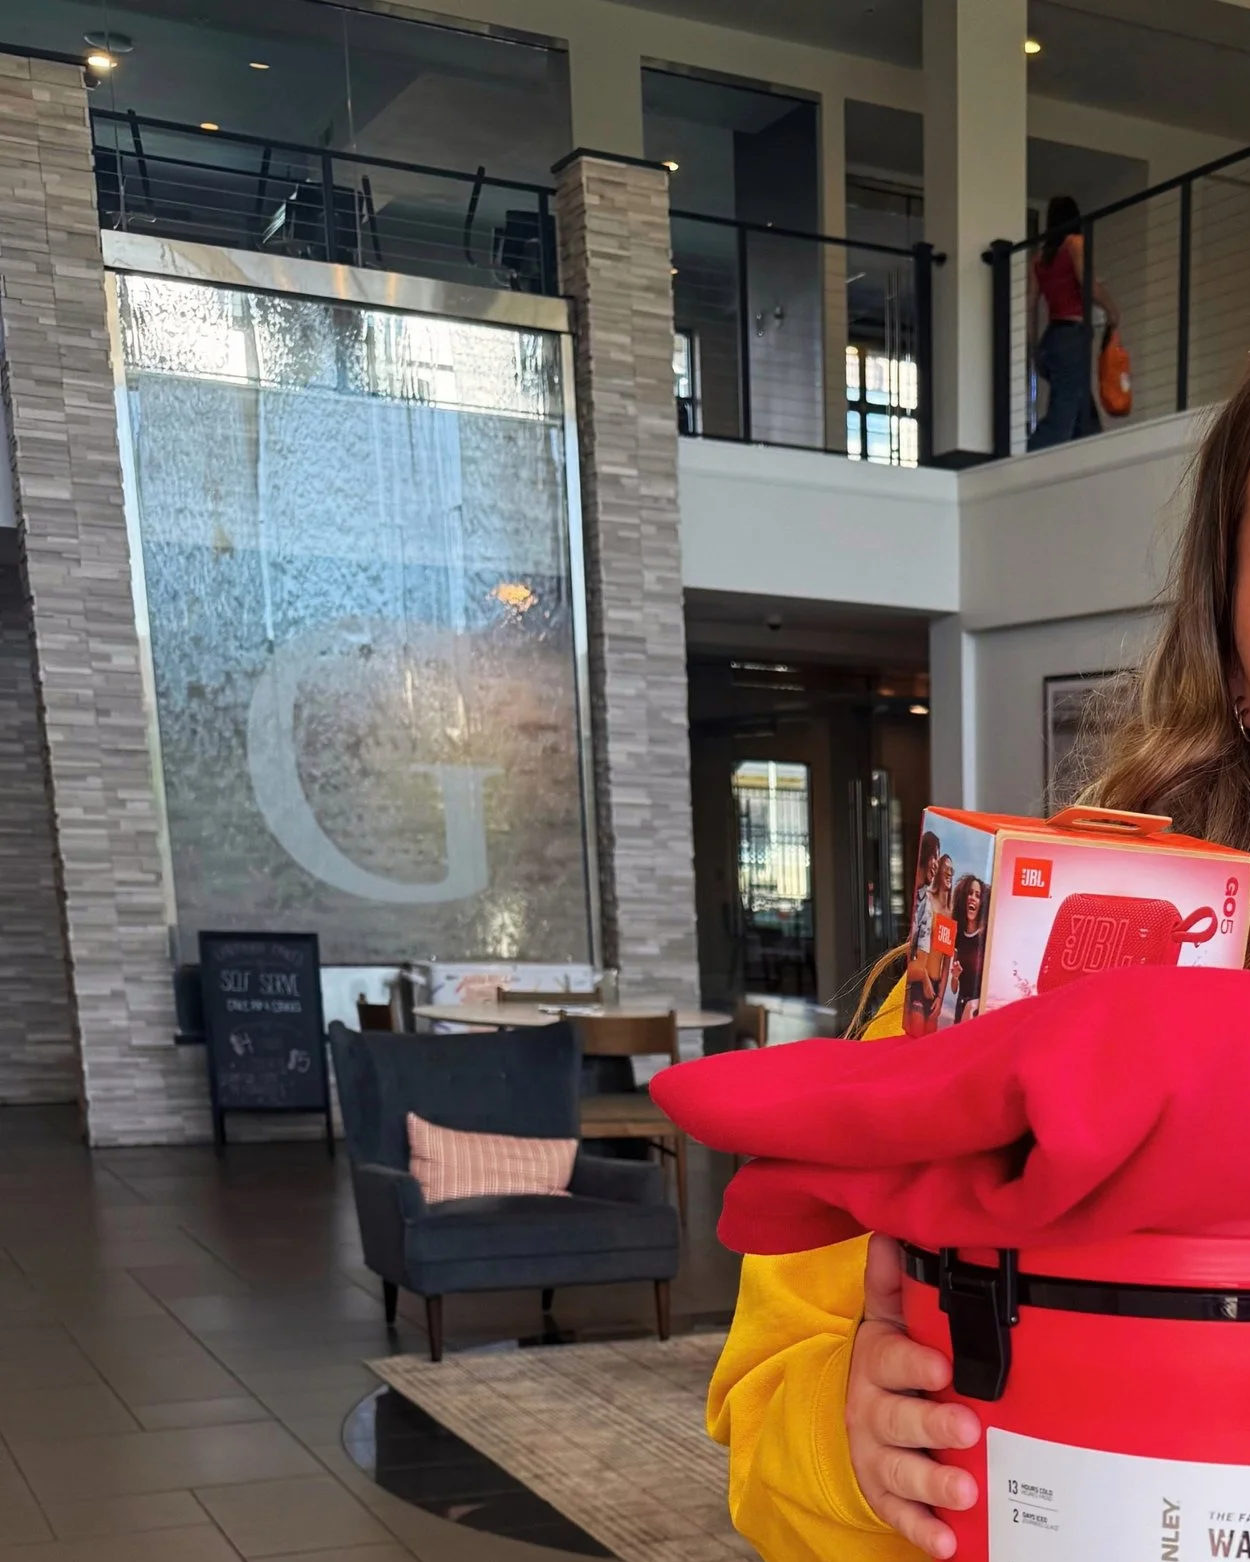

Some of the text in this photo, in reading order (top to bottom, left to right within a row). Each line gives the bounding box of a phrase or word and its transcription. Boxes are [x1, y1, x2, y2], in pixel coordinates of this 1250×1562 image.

[248, 616, 505, 902] G
[1020, 867, 1045, 889] JBL
[938, 925, 952, 946] JBL
[1061, 913, 1134, 973] JBL
[1008, 1479, 1018, 1495] 13
[1013, 1508, 1019, 1523] 2
[1208, 1511, 1235, 1522] THE
